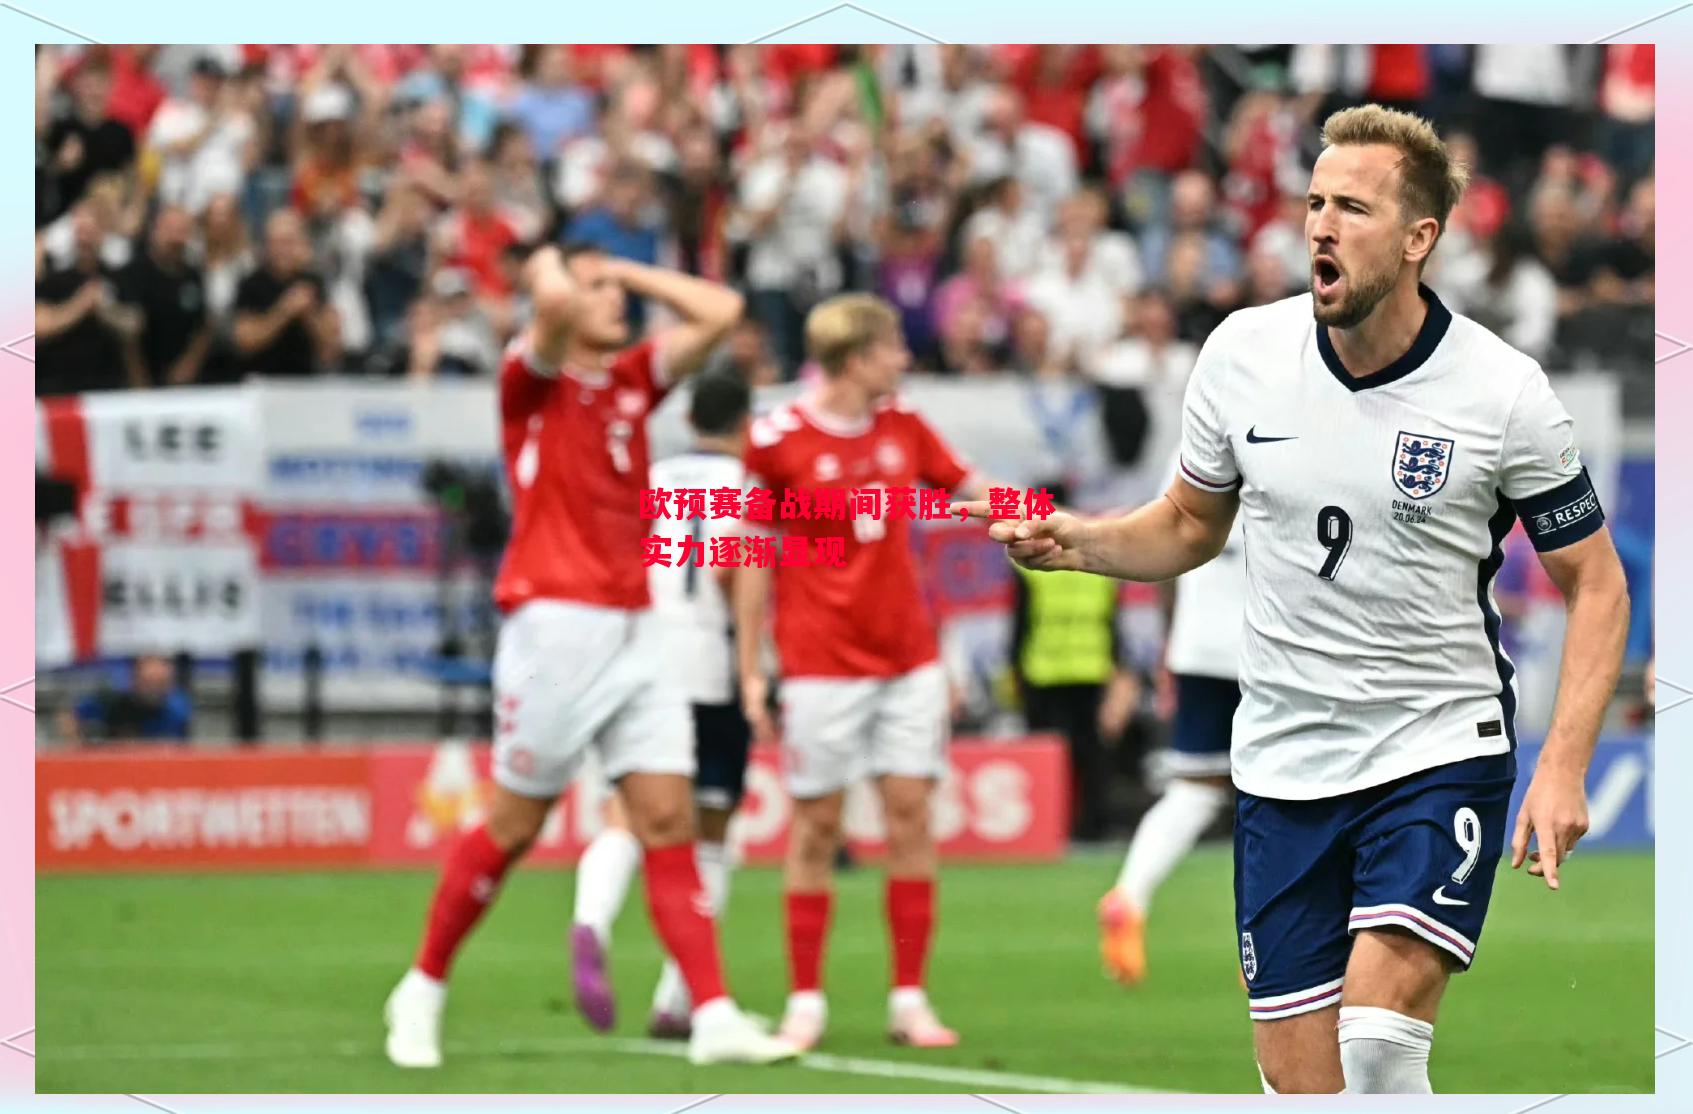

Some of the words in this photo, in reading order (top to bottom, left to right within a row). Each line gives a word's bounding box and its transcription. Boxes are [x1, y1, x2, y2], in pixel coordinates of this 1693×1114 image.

[124, 419, 222, 461] LEE
[1391, 499, 1433, 516] DENMARK
[1393, 511, 1427, 524] 20.06.24
[1317, 505, 1354, 582] 9
[1452, 806, 1482, 885] 9
